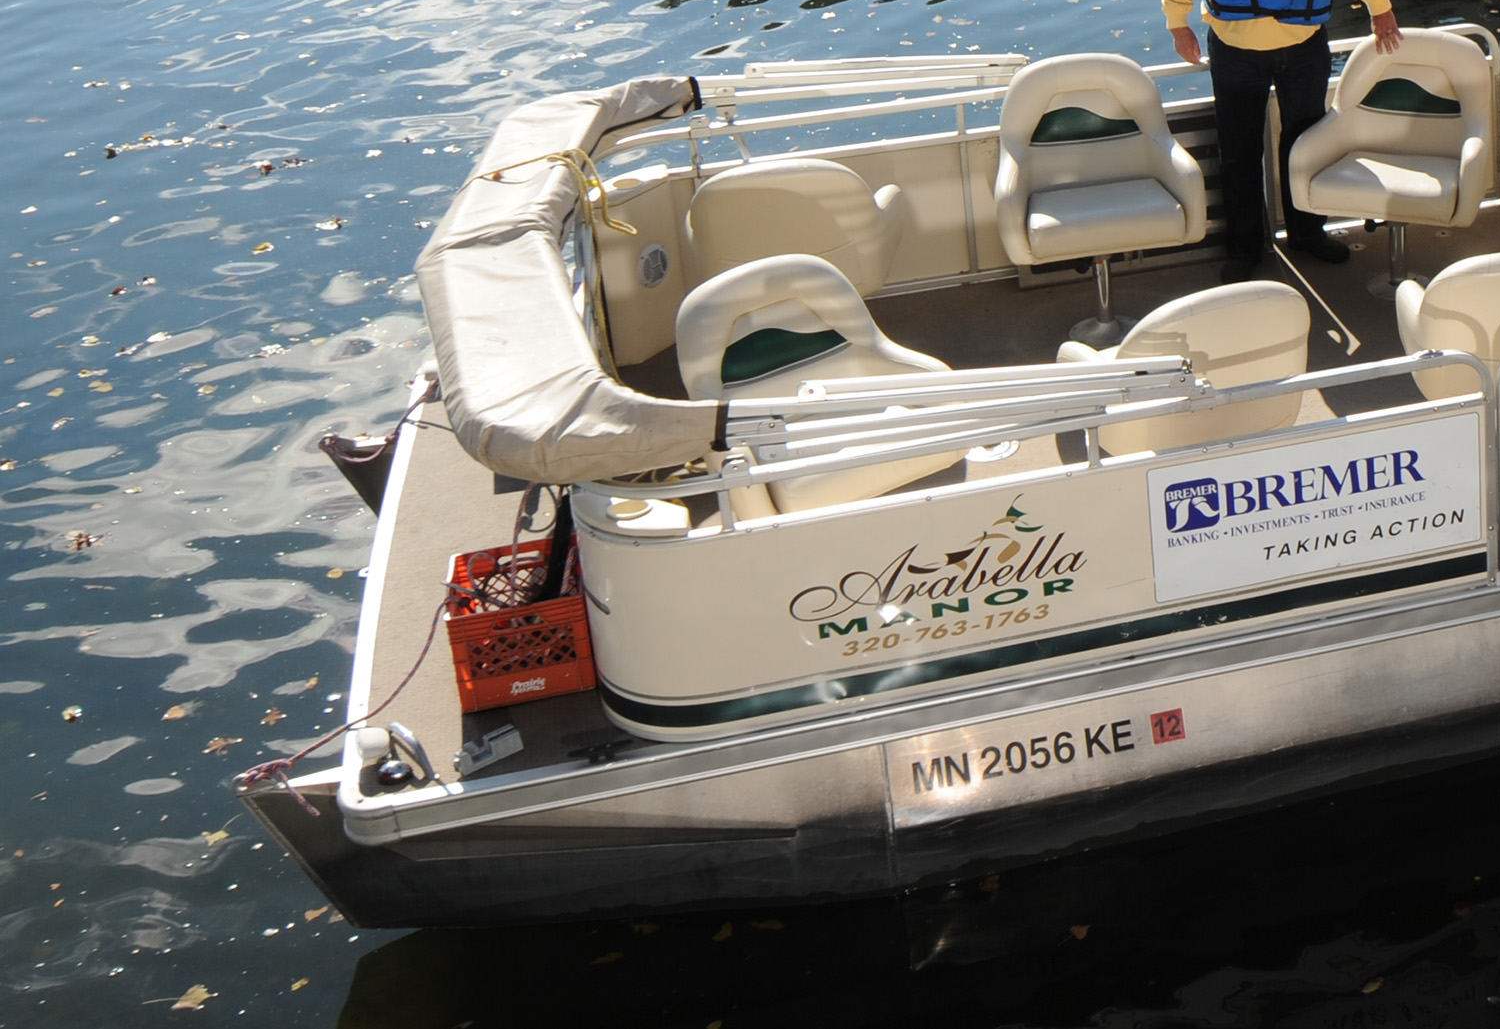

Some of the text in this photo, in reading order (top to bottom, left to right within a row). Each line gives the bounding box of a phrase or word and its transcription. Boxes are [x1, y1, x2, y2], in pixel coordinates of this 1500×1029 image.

[1165, 483, 1218, 503] BREMER
[1221, 448, 1427, 519] BREMER
[1167, 490, 1427, 549] BANKING INVESTMENTS TRUST INSURANCE
[1263, 508, 1466, 561] TAKING ACTION
[789, 532, 1088, 622] Arabella
[818, 577, 1076, 640] MANOR
[841, 603, 1051, 657] 320-763-1763
[1153, 713, 1183, 739] 12
[911, 719, 1136, 794] MN 2056 KE
